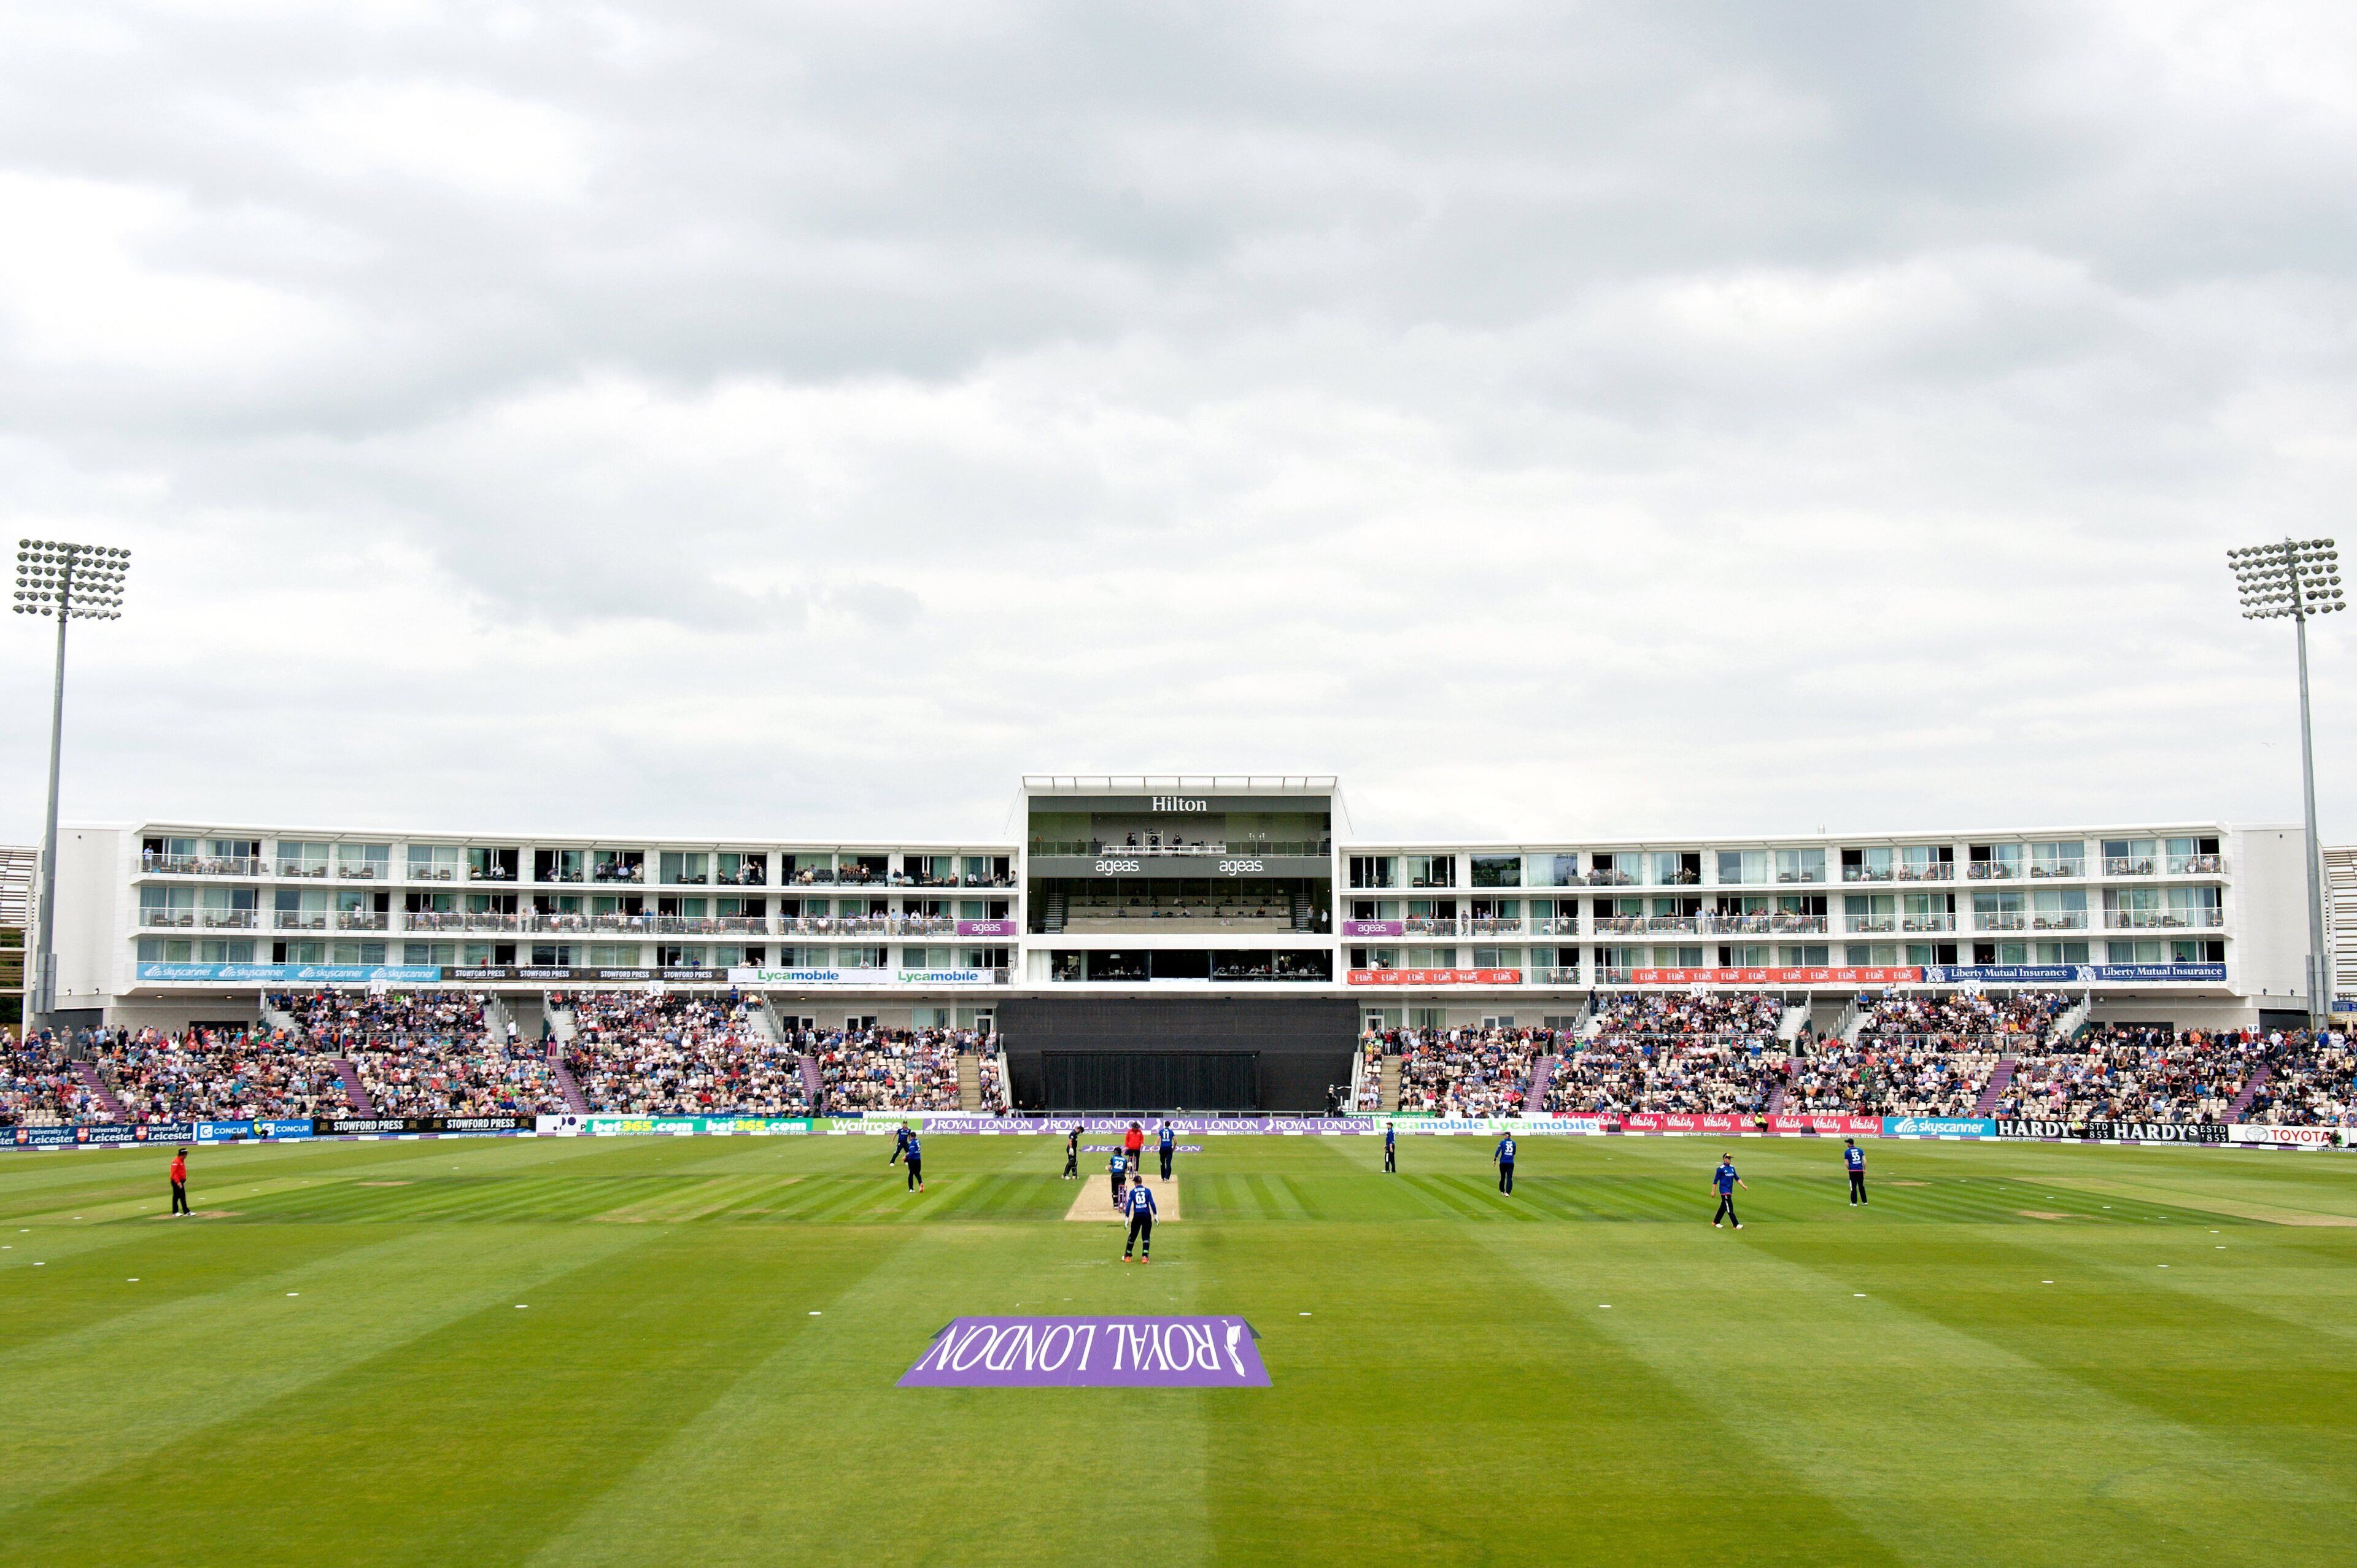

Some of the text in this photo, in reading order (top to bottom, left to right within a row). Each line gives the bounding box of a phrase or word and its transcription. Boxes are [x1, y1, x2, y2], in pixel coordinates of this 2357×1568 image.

[1152, 797, 1207, 811] Hilton
[1095, 860, 1139, 876] ageas
[1219, 860, 1263, 876] ageas
[972, 924, 1001, 934] ageas
[1358, 924, 1387, 935] ageas
[162, 967, 212, 978] skyscanner
[233, 968, 285, 978] skyscanner
[315, 968, 363, 978] skyscanner
[388, 968, 435, 979] skyscanner
[757, 970, 839, 982] Lycamobile
[898, 971, 978, 983] Lycamobile
[1951, 968, 1983, 979] Liberty
[2102, 968, 2135, 979] Liberty
[333, 1121, 404, 1131] STOWFORD PRESS
[447, 1118, 516, 1129] STOWFORD PRESS
[592, 1119, 693, 1132] bet365.com
[706, 1119, 807, 1132] bet365.com
[832, 1118, 902, 1131] Waitrose
[937, 1119, 1033, 1130] ROYAL LONDON
[1050, 1120, 1089, 1130] ROYAL
[1205, 1120, 1258, 1130] LONDON
[1275, 1120, 1371, 1130] ROYAL LONDON
[1488, 1119, 1596, 1132] Lycamobile
[1630, 1114, 1657, 1130] Vitality
[1666, 1114, 1695, 1130] Vitality
[1703, 1114, 1731, 1131] Vitality
[1813, 1116, 1841, 1132] Vitality
[1850, 1117, 1878, 1133] Vitality
[1919, 1119, 1984, 1135] skyscanner
[124, 1126, 130, 1134] of
[2113, 1124, 2199, 1141] HARDYS
[29, 1135, 75, 1145] Leicester
[90, 1133, 134, 1142] Leicester
[148, 1132, 193, 1141] Leicester
[2271, 1130, 2331, 1142] TOYOTA
[1505, 1143, 1514, 1153] 35
[1851, 1151, 1860, 1162] 55
[1113, 1161, 1124, 1170] 22
[1135, 1191, 1146, 1205] 63
[915, 1323, 1221, 1372] ROYAL LONDON
